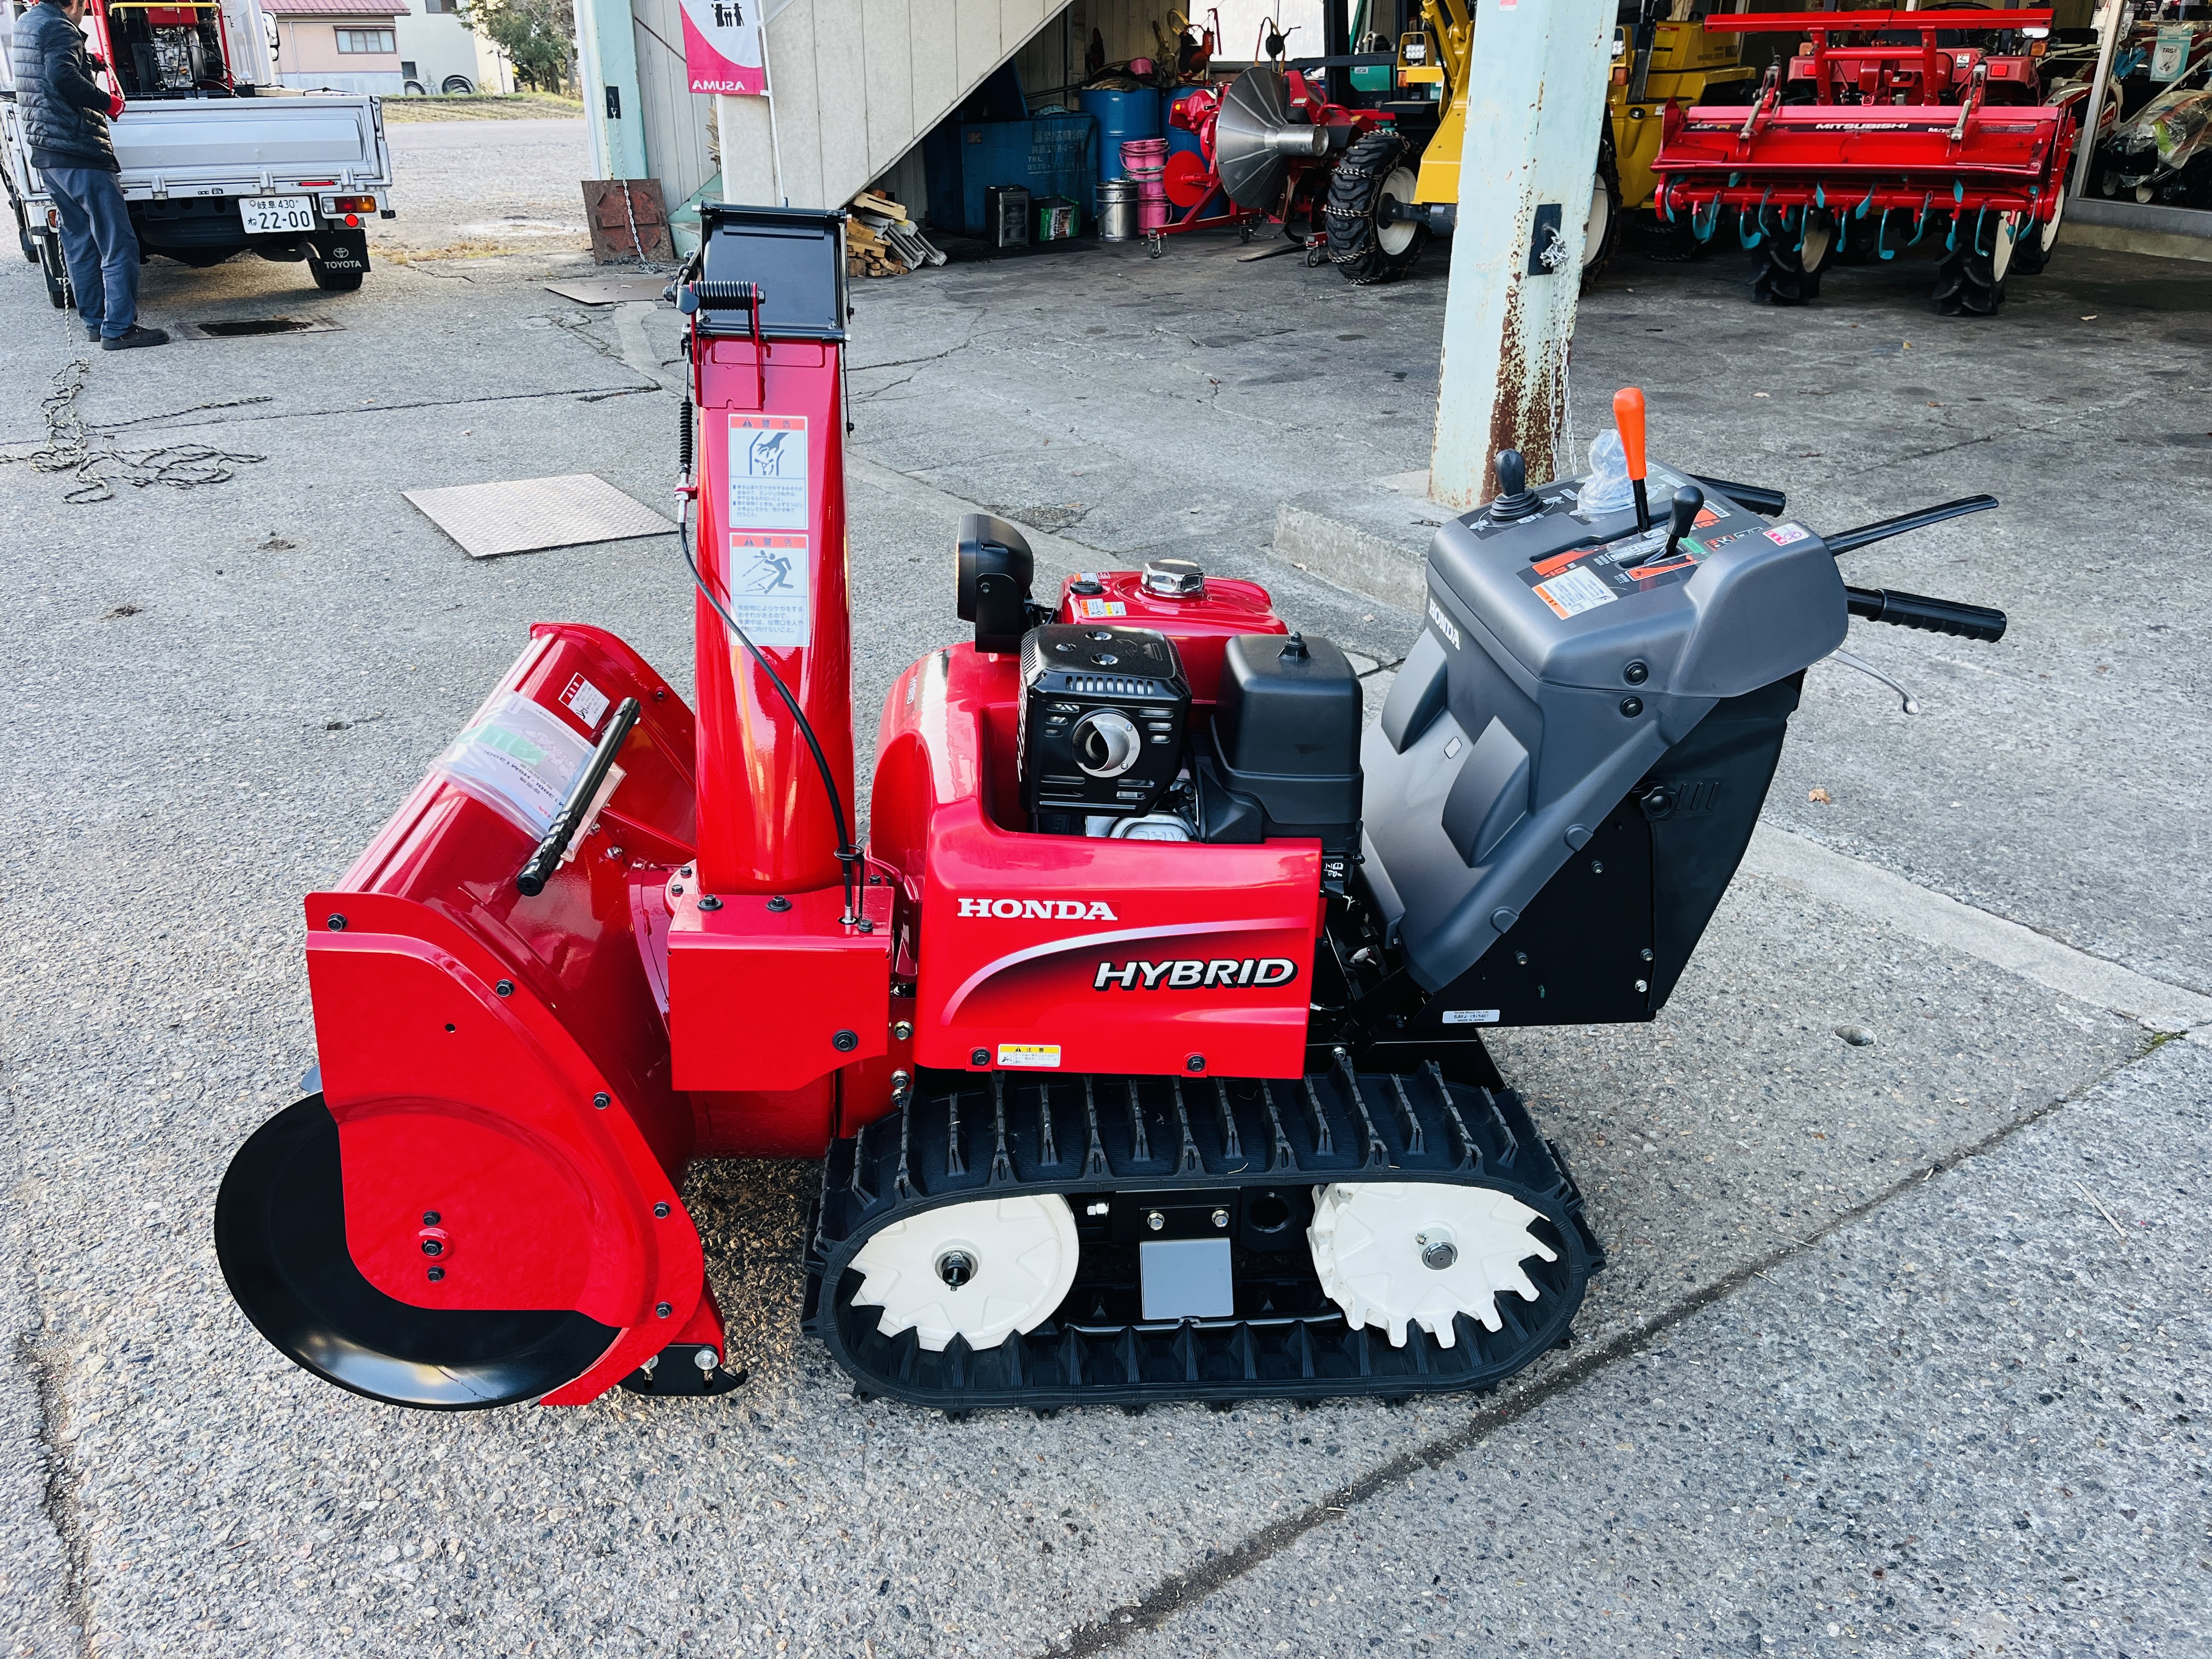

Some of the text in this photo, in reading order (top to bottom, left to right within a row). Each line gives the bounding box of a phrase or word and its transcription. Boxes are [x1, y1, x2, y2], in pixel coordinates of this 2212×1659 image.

[257, 199, 295, 209] 岐阜 430
[247, 211, 310, 229] ね 22-00
[324, 260, 362, 269] TOYOTA
[1428, 597, 1460, 651] HONDA
[957, 898, 1118, 921] HONDA
[1094, 959, 1296, 989] HYBRID
